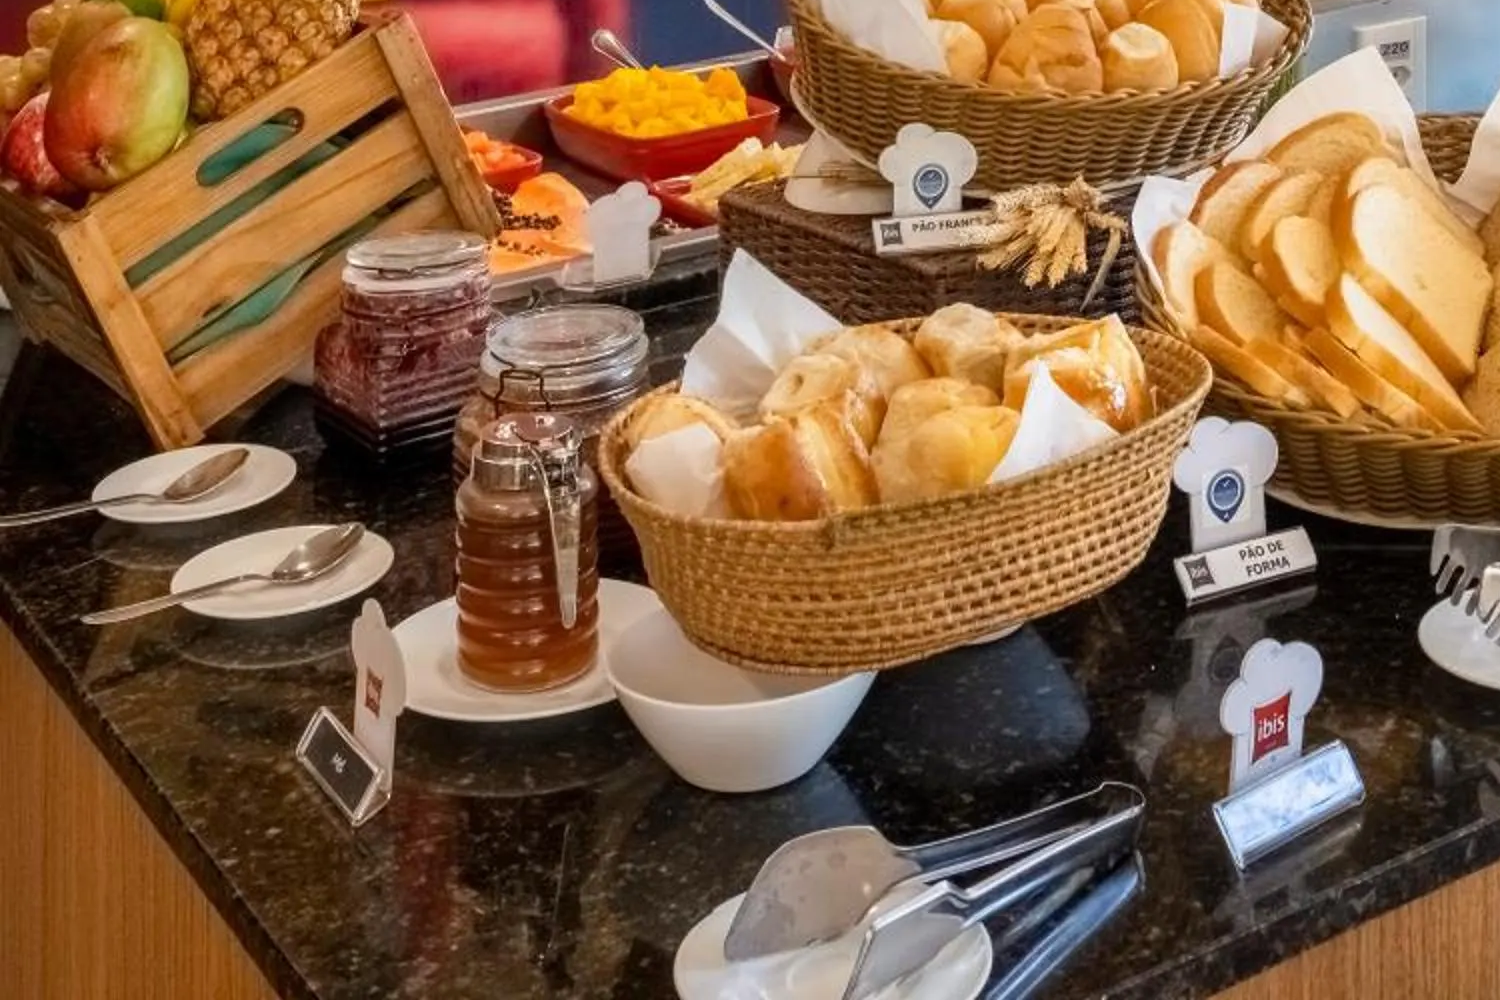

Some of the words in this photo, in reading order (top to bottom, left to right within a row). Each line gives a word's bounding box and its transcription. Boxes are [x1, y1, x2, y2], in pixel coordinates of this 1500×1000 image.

[912, 220, 936, 232] PÃO
[1238, 544, 1265, 560] PÃO
[1268, 540, 1285, 552] DE
[1245, 556, 1291, 577] FORMA
[1257, 713, 1285, 742] ibis
